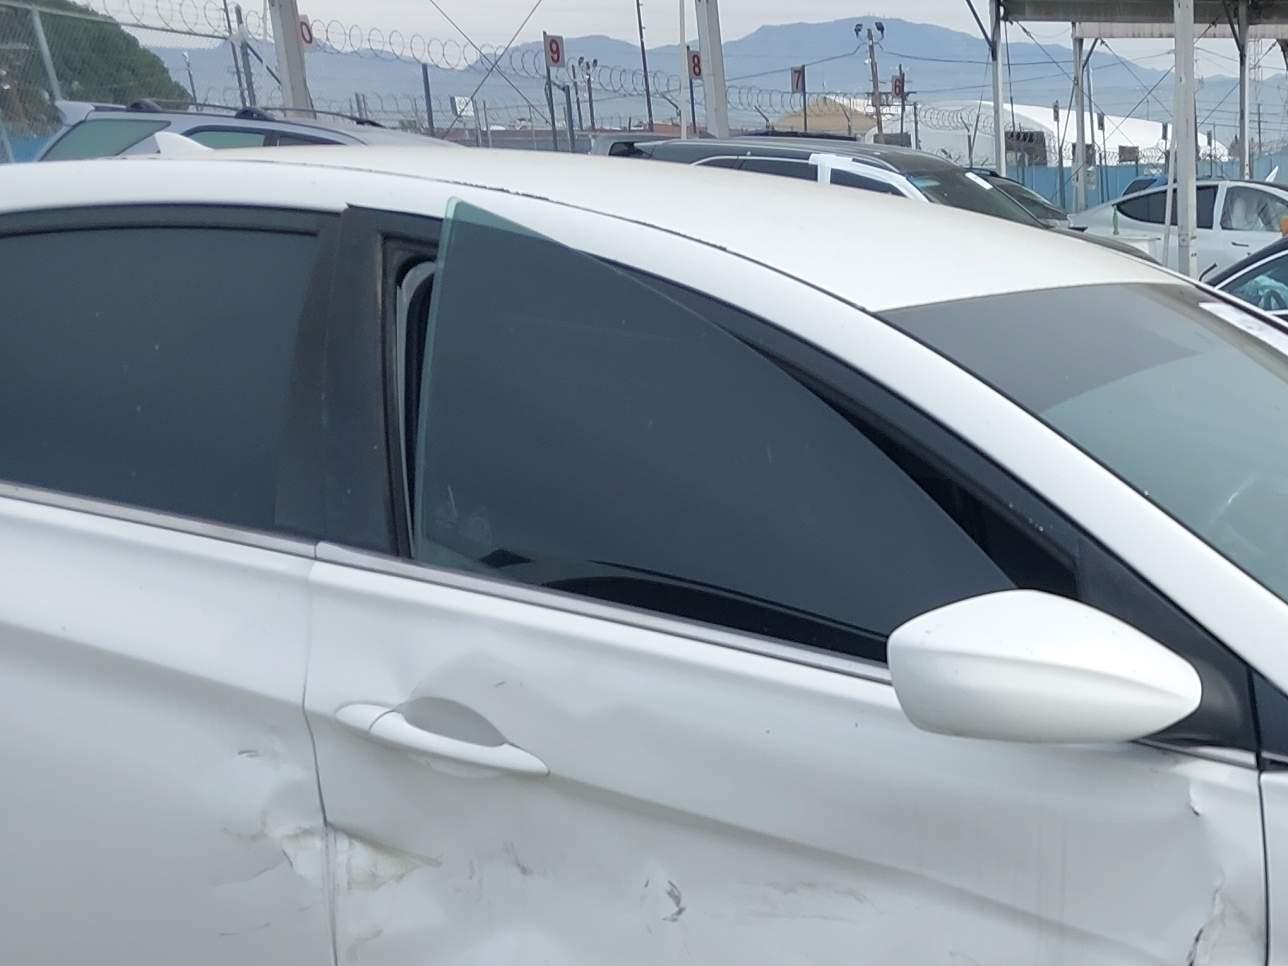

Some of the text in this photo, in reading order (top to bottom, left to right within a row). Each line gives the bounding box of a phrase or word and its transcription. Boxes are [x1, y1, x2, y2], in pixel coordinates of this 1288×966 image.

[550, 39, 560, 64] 9
[692, 54, 702, 77] 8
[793, 70, 801, 89] 7
[894, 78, 902, 96] 6
